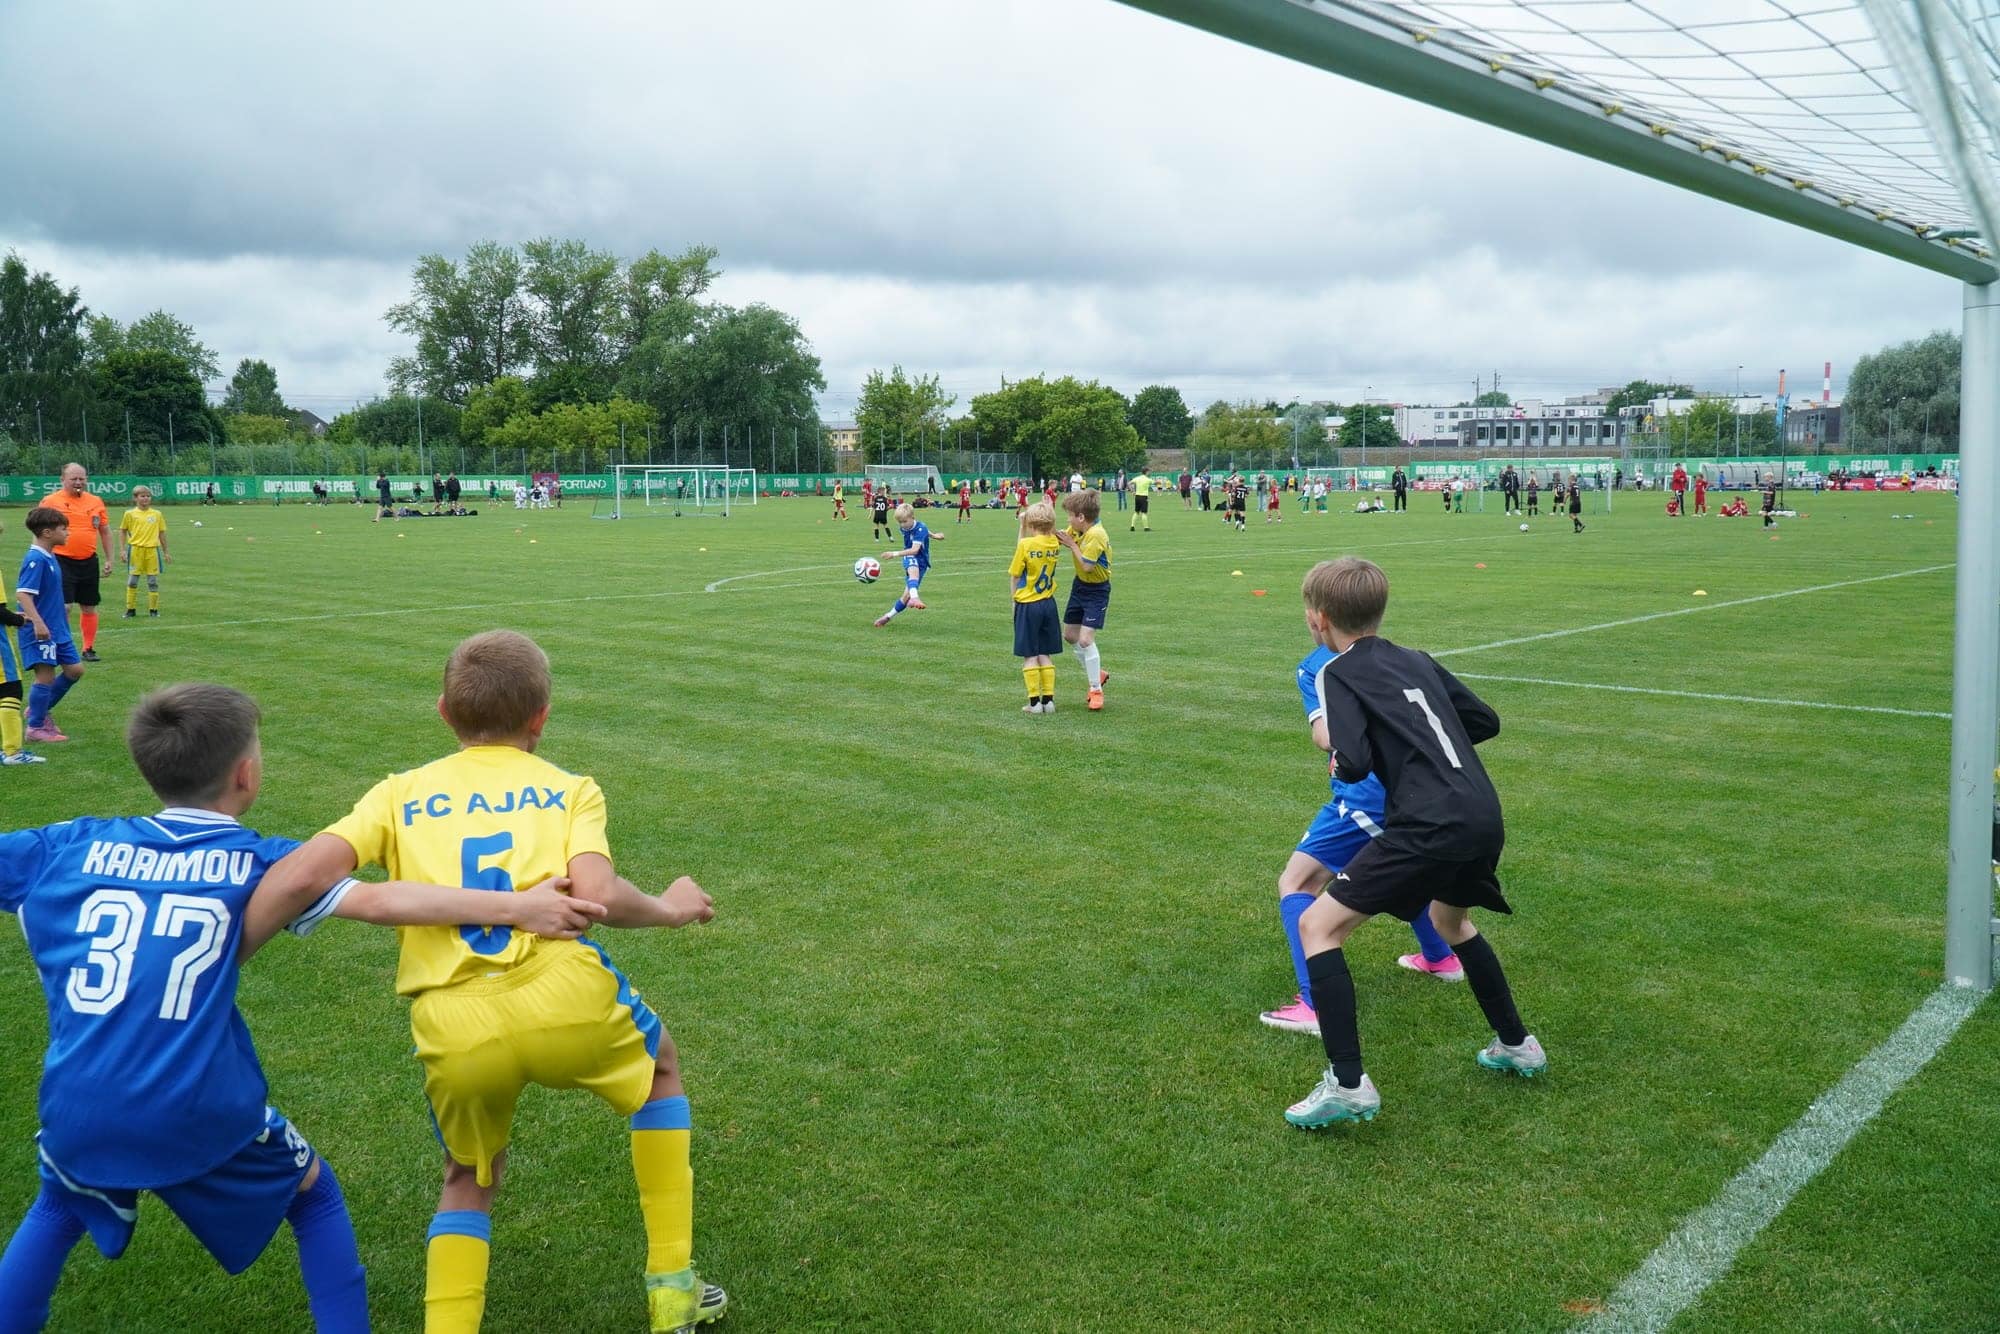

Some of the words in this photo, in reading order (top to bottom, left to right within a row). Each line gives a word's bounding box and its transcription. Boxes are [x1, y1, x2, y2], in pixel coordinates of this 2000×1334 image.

[1850, 459, 1862, 472] FC
[43, 482, 127, 495] SPTLAND
[176, 482, 189, 495] FC
[190, 482, 221, 495] FLOA
[558, 479, 607, 489] PORTLAND
[773, 478, 781, 488] FC
[1236, 490, 1245, 499] 21
[875, 502, 886, 511] 20
[1030, 550, 1043, 559] FC
[1046, 549, 1060, 558] AJA
[39, 643, 57, 661] 70
[1402, 688, 1463, 768] 1
[403, 793, 453, 826] FC
[467, 786, 566, 814] AJAX
[82, 840, 255, 886] KARIMOV
[459, 831, 514, 956] 5
[65, 888, 233, 1022] 37
